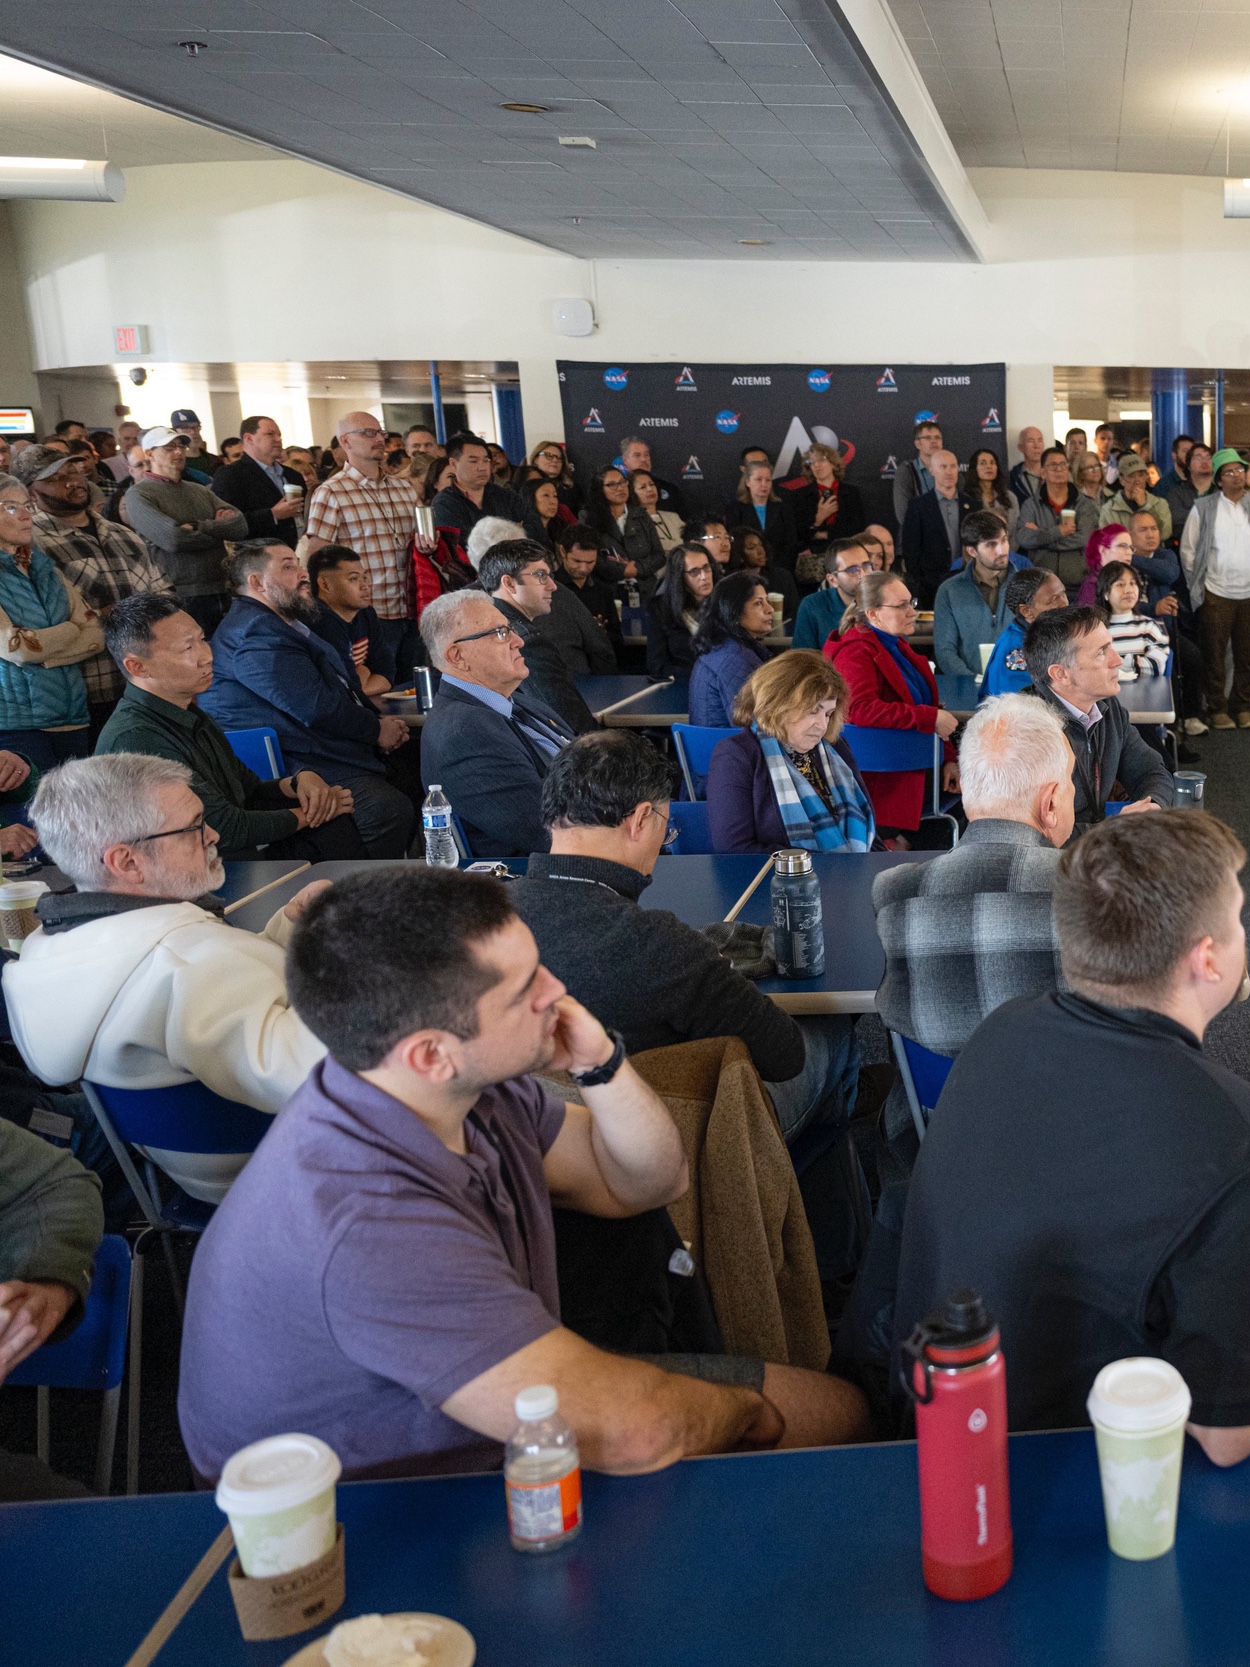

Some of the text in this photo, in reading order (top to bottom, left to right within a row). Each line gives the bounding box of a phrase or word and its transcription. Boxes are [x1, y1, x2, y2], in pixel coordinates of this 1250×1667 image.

[117, 327, 136, 351] EXIT
[605, 375, 627, 383] NASA
[731, 376, 772, 386] ARTEMIS
[808, 377, 830, 385] NASA
[931, 376, 971, 386] ARTEMIS
[639, 418, 679, 427] ARTEMIS
[716, 418, 738, 426] NASA
